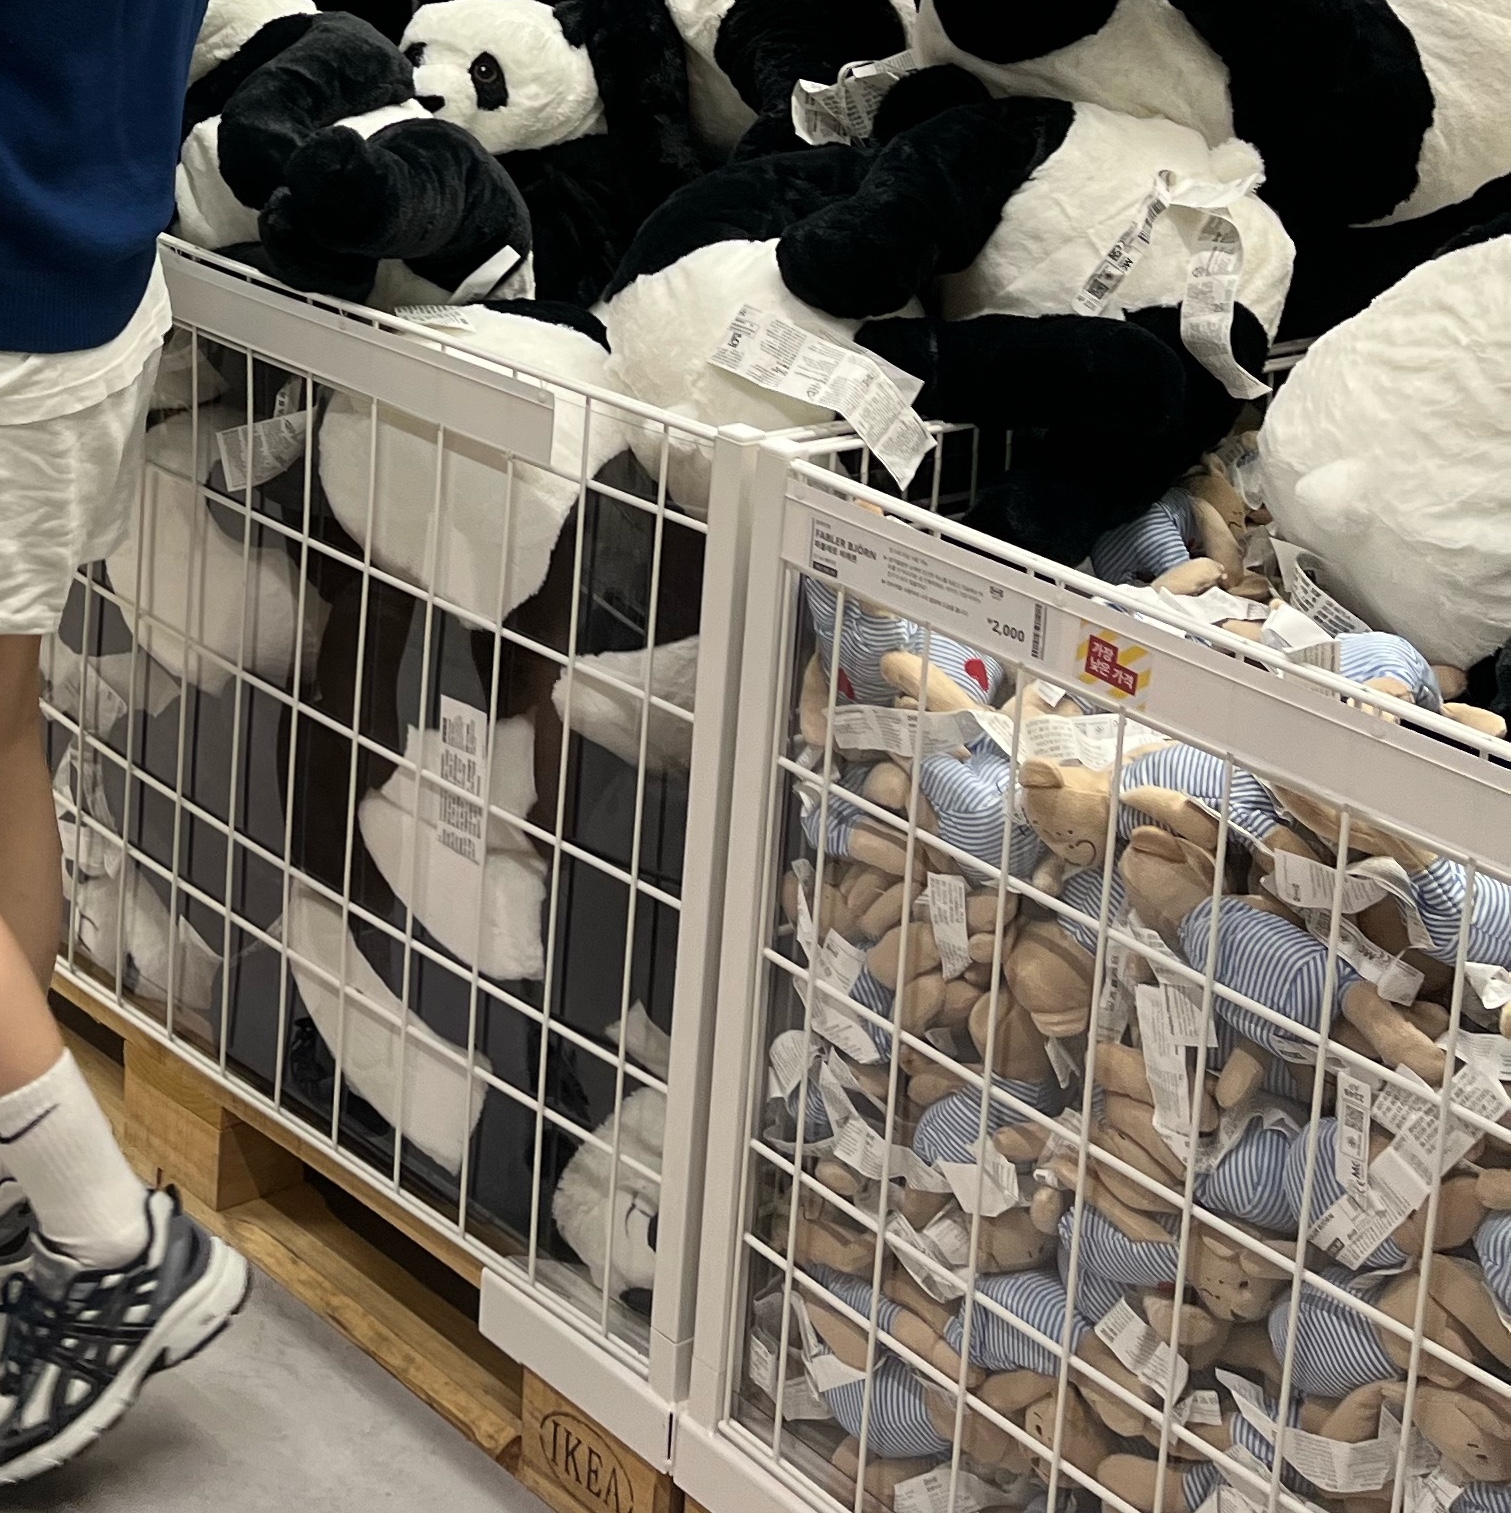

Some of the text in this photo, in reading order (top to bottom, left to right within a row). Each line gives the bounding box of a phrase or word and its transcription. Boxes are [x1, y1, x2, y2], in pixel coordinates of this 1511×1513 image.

[1091, 642, 1114, 662] 가장
[1090, 657, 1134, 690] 낮은 가격
[550, 1420, 622, 1513] IKEA
